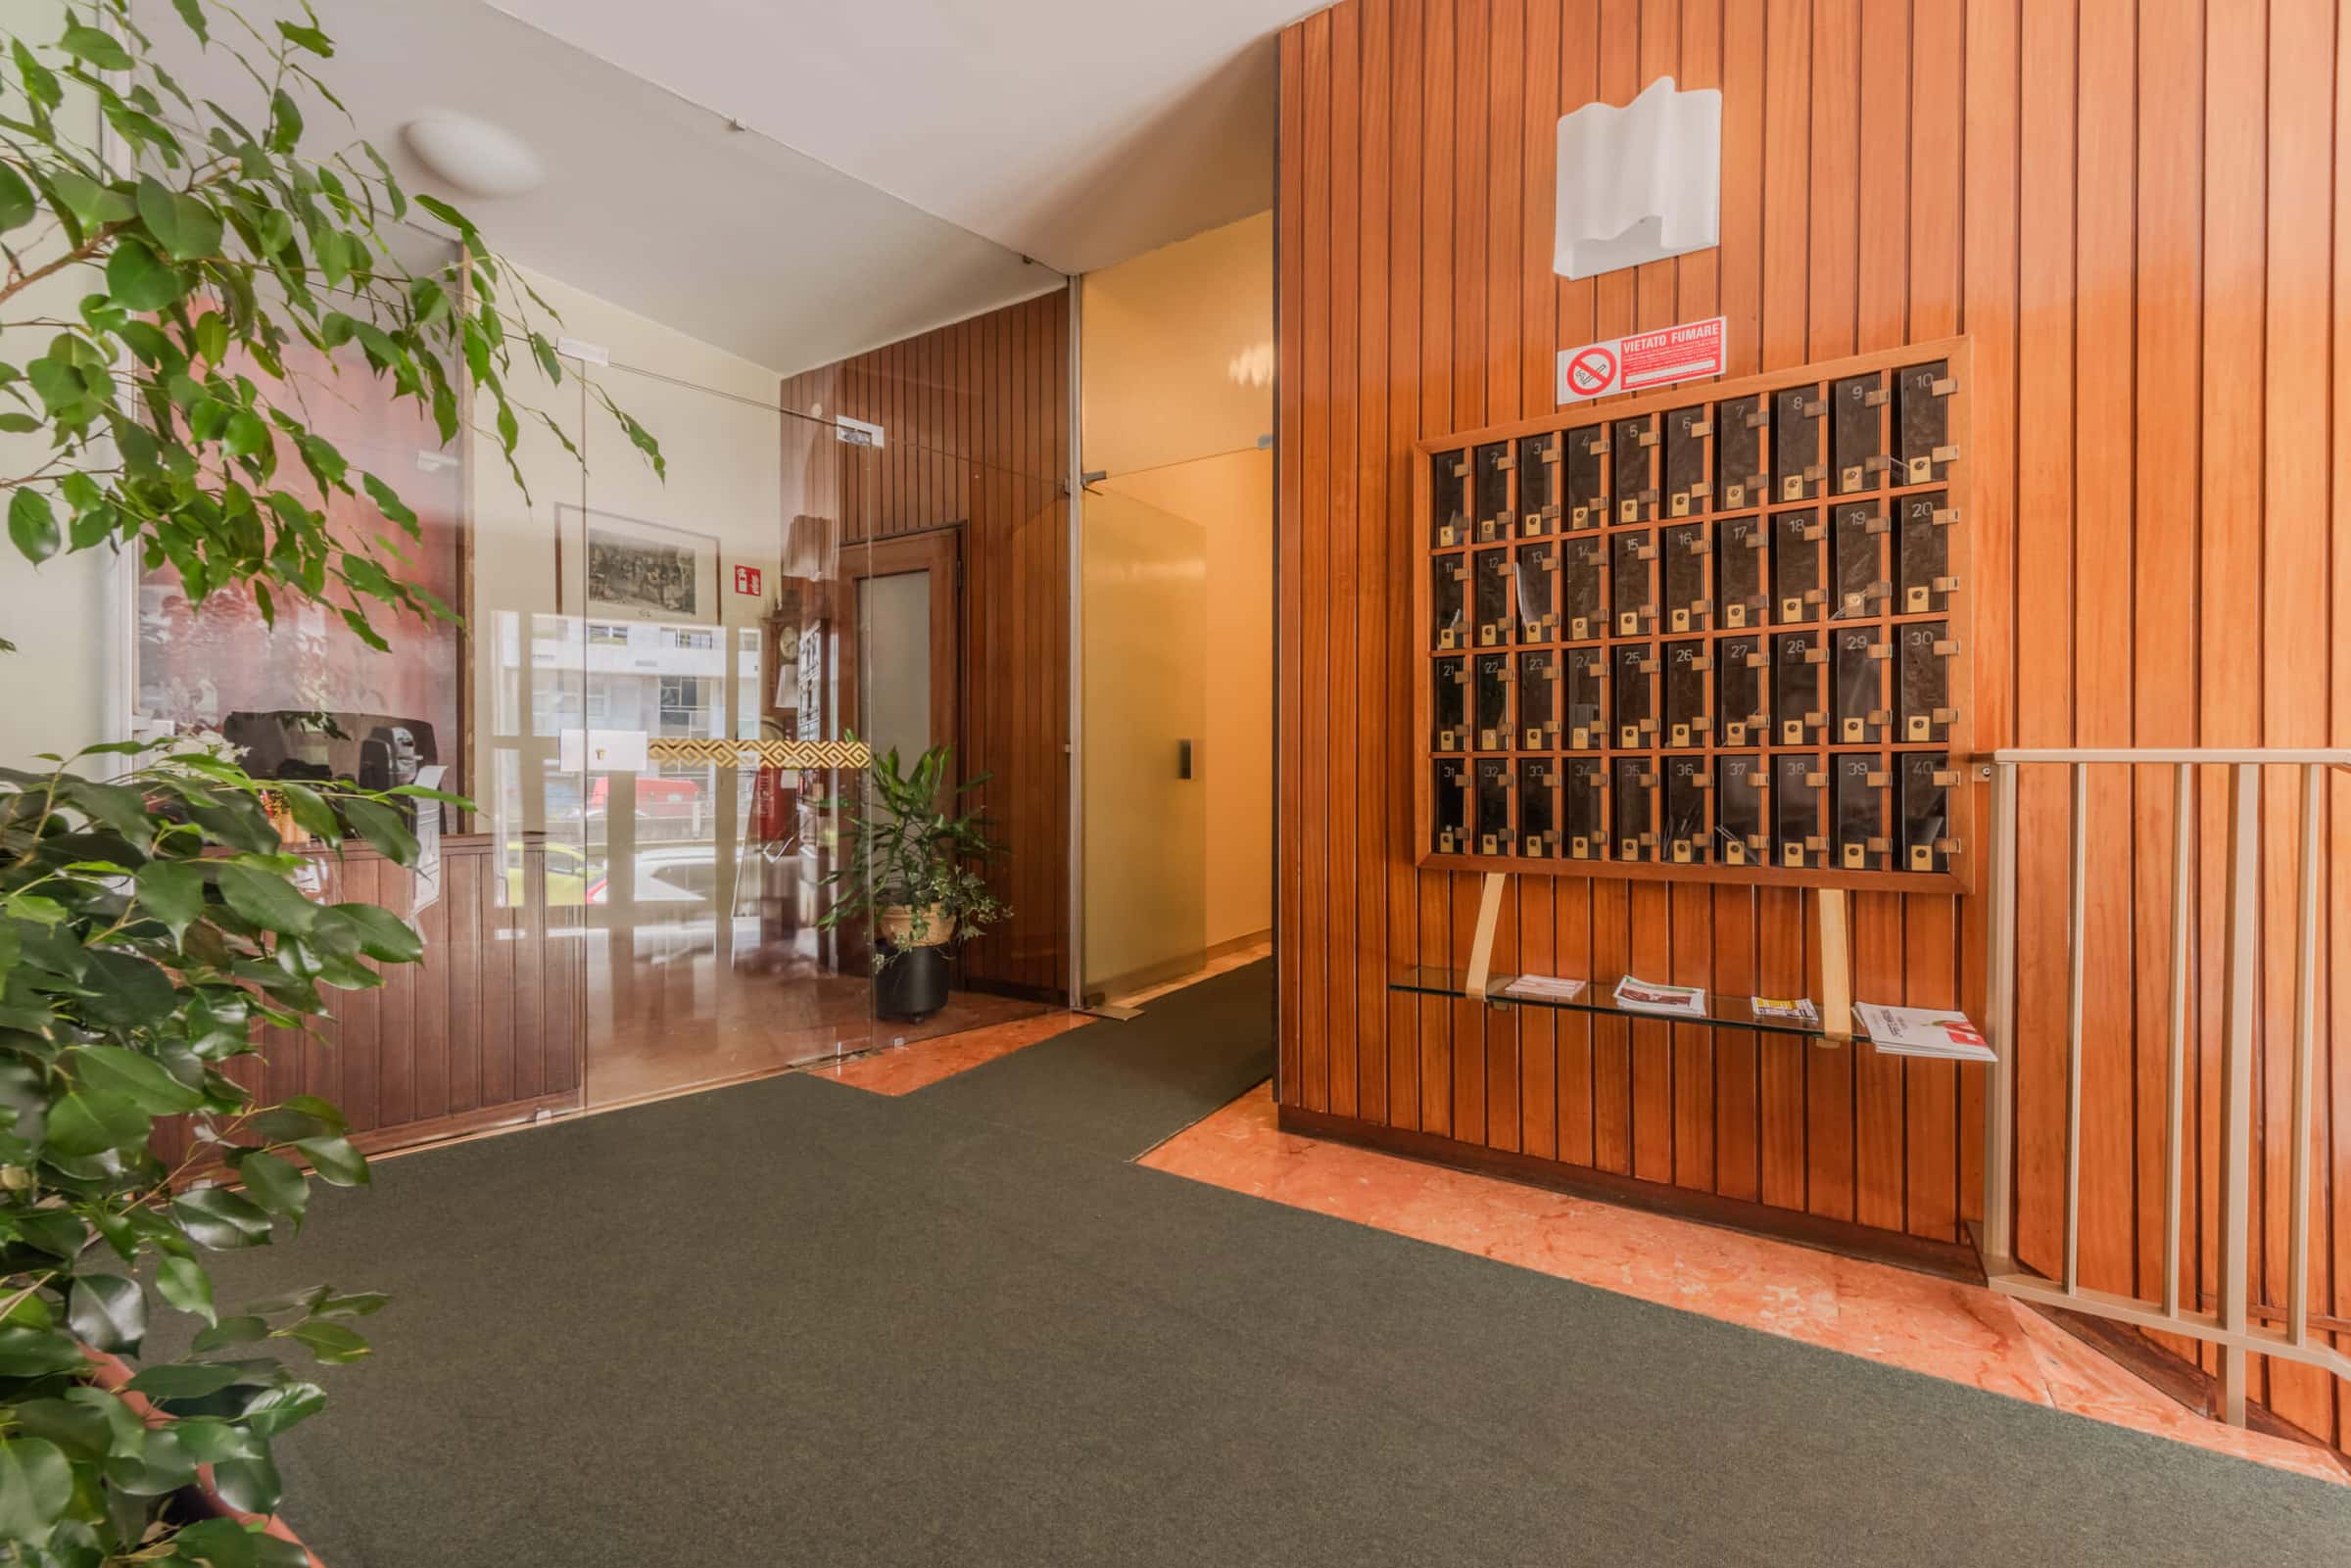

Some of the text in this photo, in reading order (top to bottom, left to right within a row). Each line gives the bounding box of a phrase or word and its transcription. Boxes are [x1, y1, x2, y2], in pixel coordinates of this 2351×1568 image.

[1623, 323, 1719, 354] VIETATO FUMARE
[1915, 372, 1934, 389] 10
[1852, 386, 1862, 400] 9
[1793, 396, 1802, 409] 8
[1736, 404, 1745, 418] 7
[1682, 416, 1692, 430] 6
[1629, 424, 1639, 438] 5
[1533, 443, 1542, 454] 3
[1490, 451, 1498, 463] 2
[1912, 501, 1933, 518] 20
[1789, 518, 1804, 533] 18
[1849, 511, 1865, 526] 19
[1678, 532, 1692, 546] 16
[1733, 526, 1748, 540] 17
[1578, 546, 1590, 558] 14
[1626, 539, 1639, 551] 15
[1488, 556, 1498, 569] 12
[1532, 550, 1543, 563] 13
[1847, 636, 1867, 650] 29
[1911, 631, 1933, 645] 30
[1731, 644, 1748, 658] 27
[1787, 640, 1805, 654] 28
[1625, 651, 1640, 665] 25
[1676, 649, 1693, 662] 26
[1443, 665, 1455, 677] 21
[1485, 661, 1498, 674] 22
[1529, 658, 1543, 671] 23
[1443, 766, 1455, 778] 31
[1484, 766, 1498, 778] 32
[1529, 765, 1544, 777] 33
[1676, 764, 1693, 777] 36
[1729, 763, 1747, 776] 37
[1787, 762, 1805, 776] 38
[1848, 762, 1867, 776] 39
[1912, 760, 1934, 776] 40
